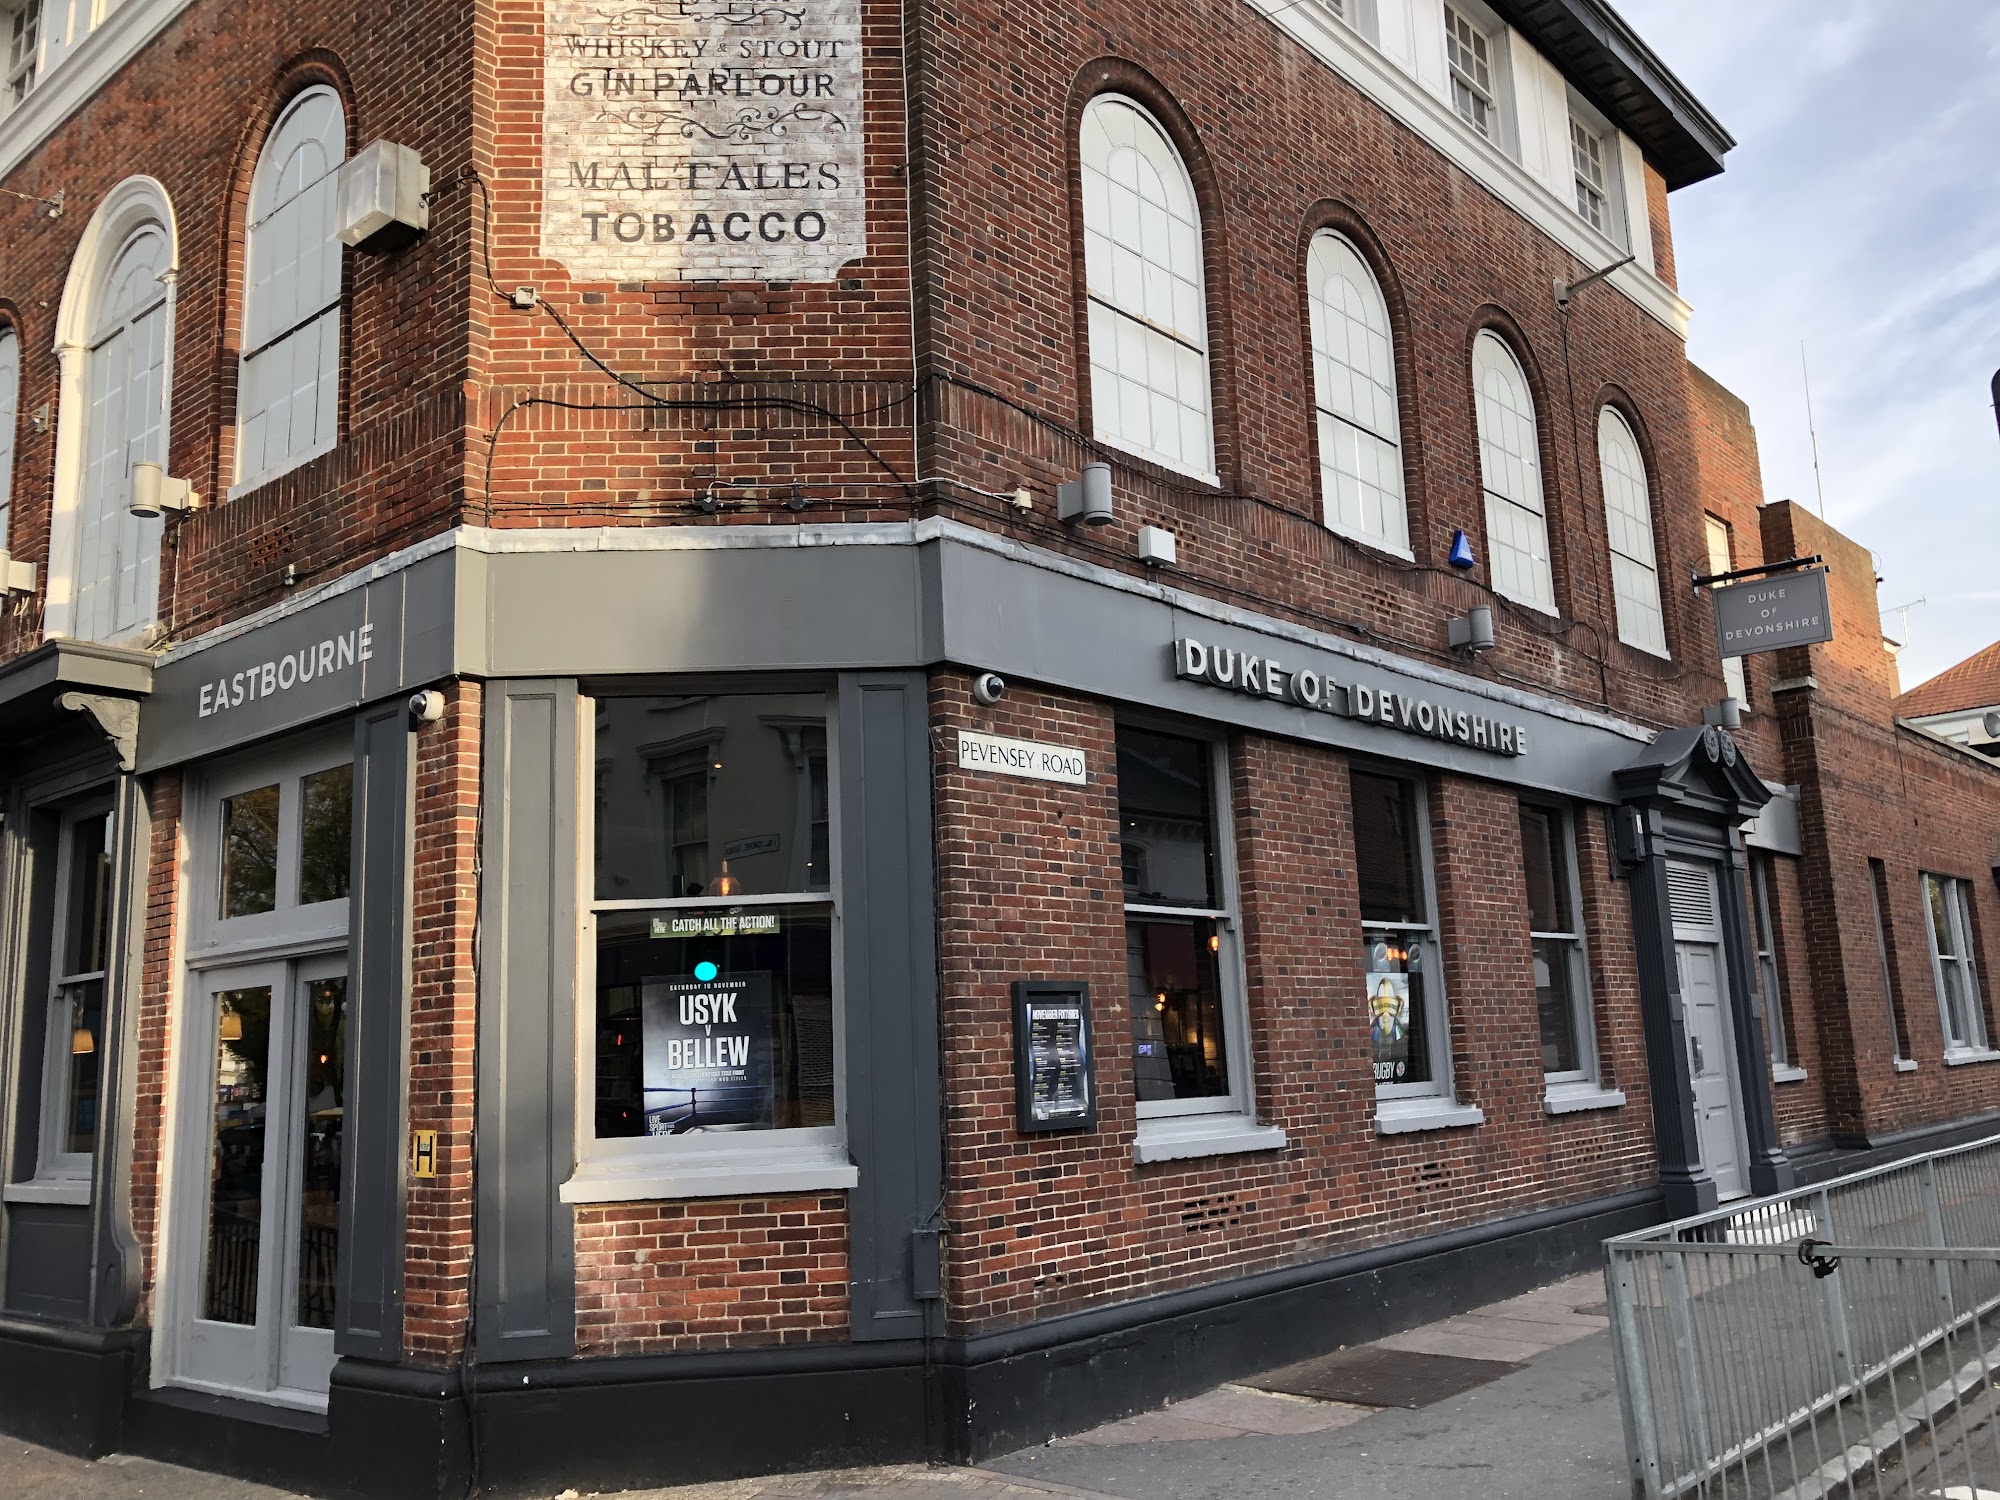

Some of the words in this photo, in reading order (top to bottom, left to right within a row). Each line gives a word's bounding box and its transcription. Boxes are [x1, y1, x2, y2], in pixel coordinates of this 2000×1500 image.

[563, 39, 712, 59] WHISKEY
[717, 43, 728, 53] &
[740, 39, 844, 59] STOUT
[570, 73, 634, 96] GIN
[655, 73, 836, 97] PARLOUR
[567, 162, 711, 190] MALT
[716, 162, 841, 190] ALES
[582, 211, 826, 243] TOBACCO
[1748, 588, 1787, 604] DUKE
[1761, 607, 1777, 619] OF
[1725, 616, 1820, 640] DEVONSHIRE
[199, 623, 374, 718] EASTBOURNE
[1179, 638, 1283, 695] DUKE
[1293, 668, 1337, 708] OF
[1352, 684, 1528, 756] DEVONSHIRE
[961, 741, 1035, 769] PEVENSEY
[1042, 753, 1083, 776] ROAD
[672, 918, 701, 932] CATCH
[704, 917, 719, 931] ALL
[720, 916, 737, 930] THE
[739, 915, 775, 929] ACTION!
[669, 983, 701, 991] SATURDAY
[713, 981, 746, 989] NOVEMBER
[679, 992, 738, 1025] USYK
[667, 1036, 750, 1070] BELLEW
[649, 1115, 661, 1124] LIVE
[649, 1123, 667, 1131] SPORT
[416, 1135, 433, 1173] H
